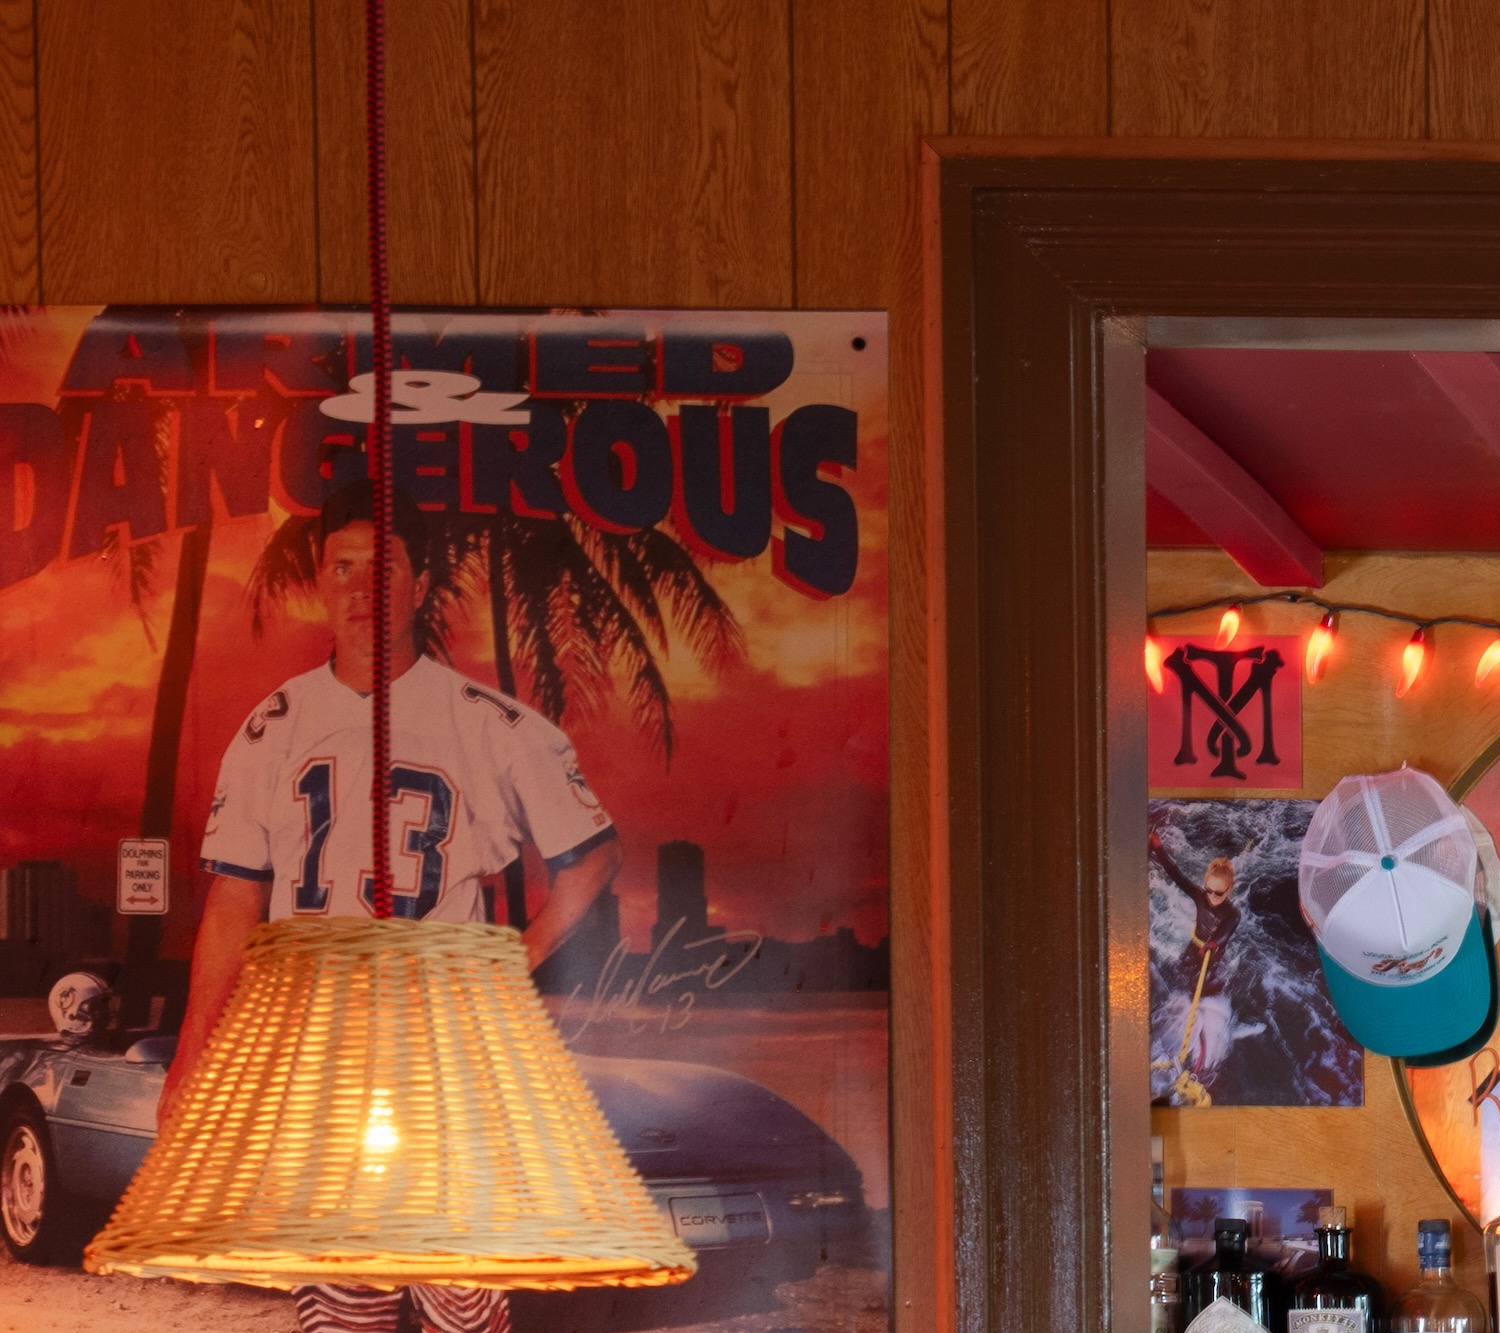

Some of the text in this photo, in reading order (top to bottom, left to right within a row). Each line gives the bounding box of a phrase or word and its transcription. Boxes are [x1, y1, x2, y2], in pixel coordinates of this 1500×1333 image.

[58, 308, 795, 399] ARMED
[319, 369, 531, 425] &
[0, 400, 860, 600] DANGEROUS
[289, 756, 461, 921] 13
[122, 848, 163, 859] DOLPHINS
[125, 870, 160, 880] PARKING
[131, 882, 153, 892] ONLY
[679, 1210, 762, 1226] CORVETTE
[1293, 1313, 1342, 1329] MONKEY
